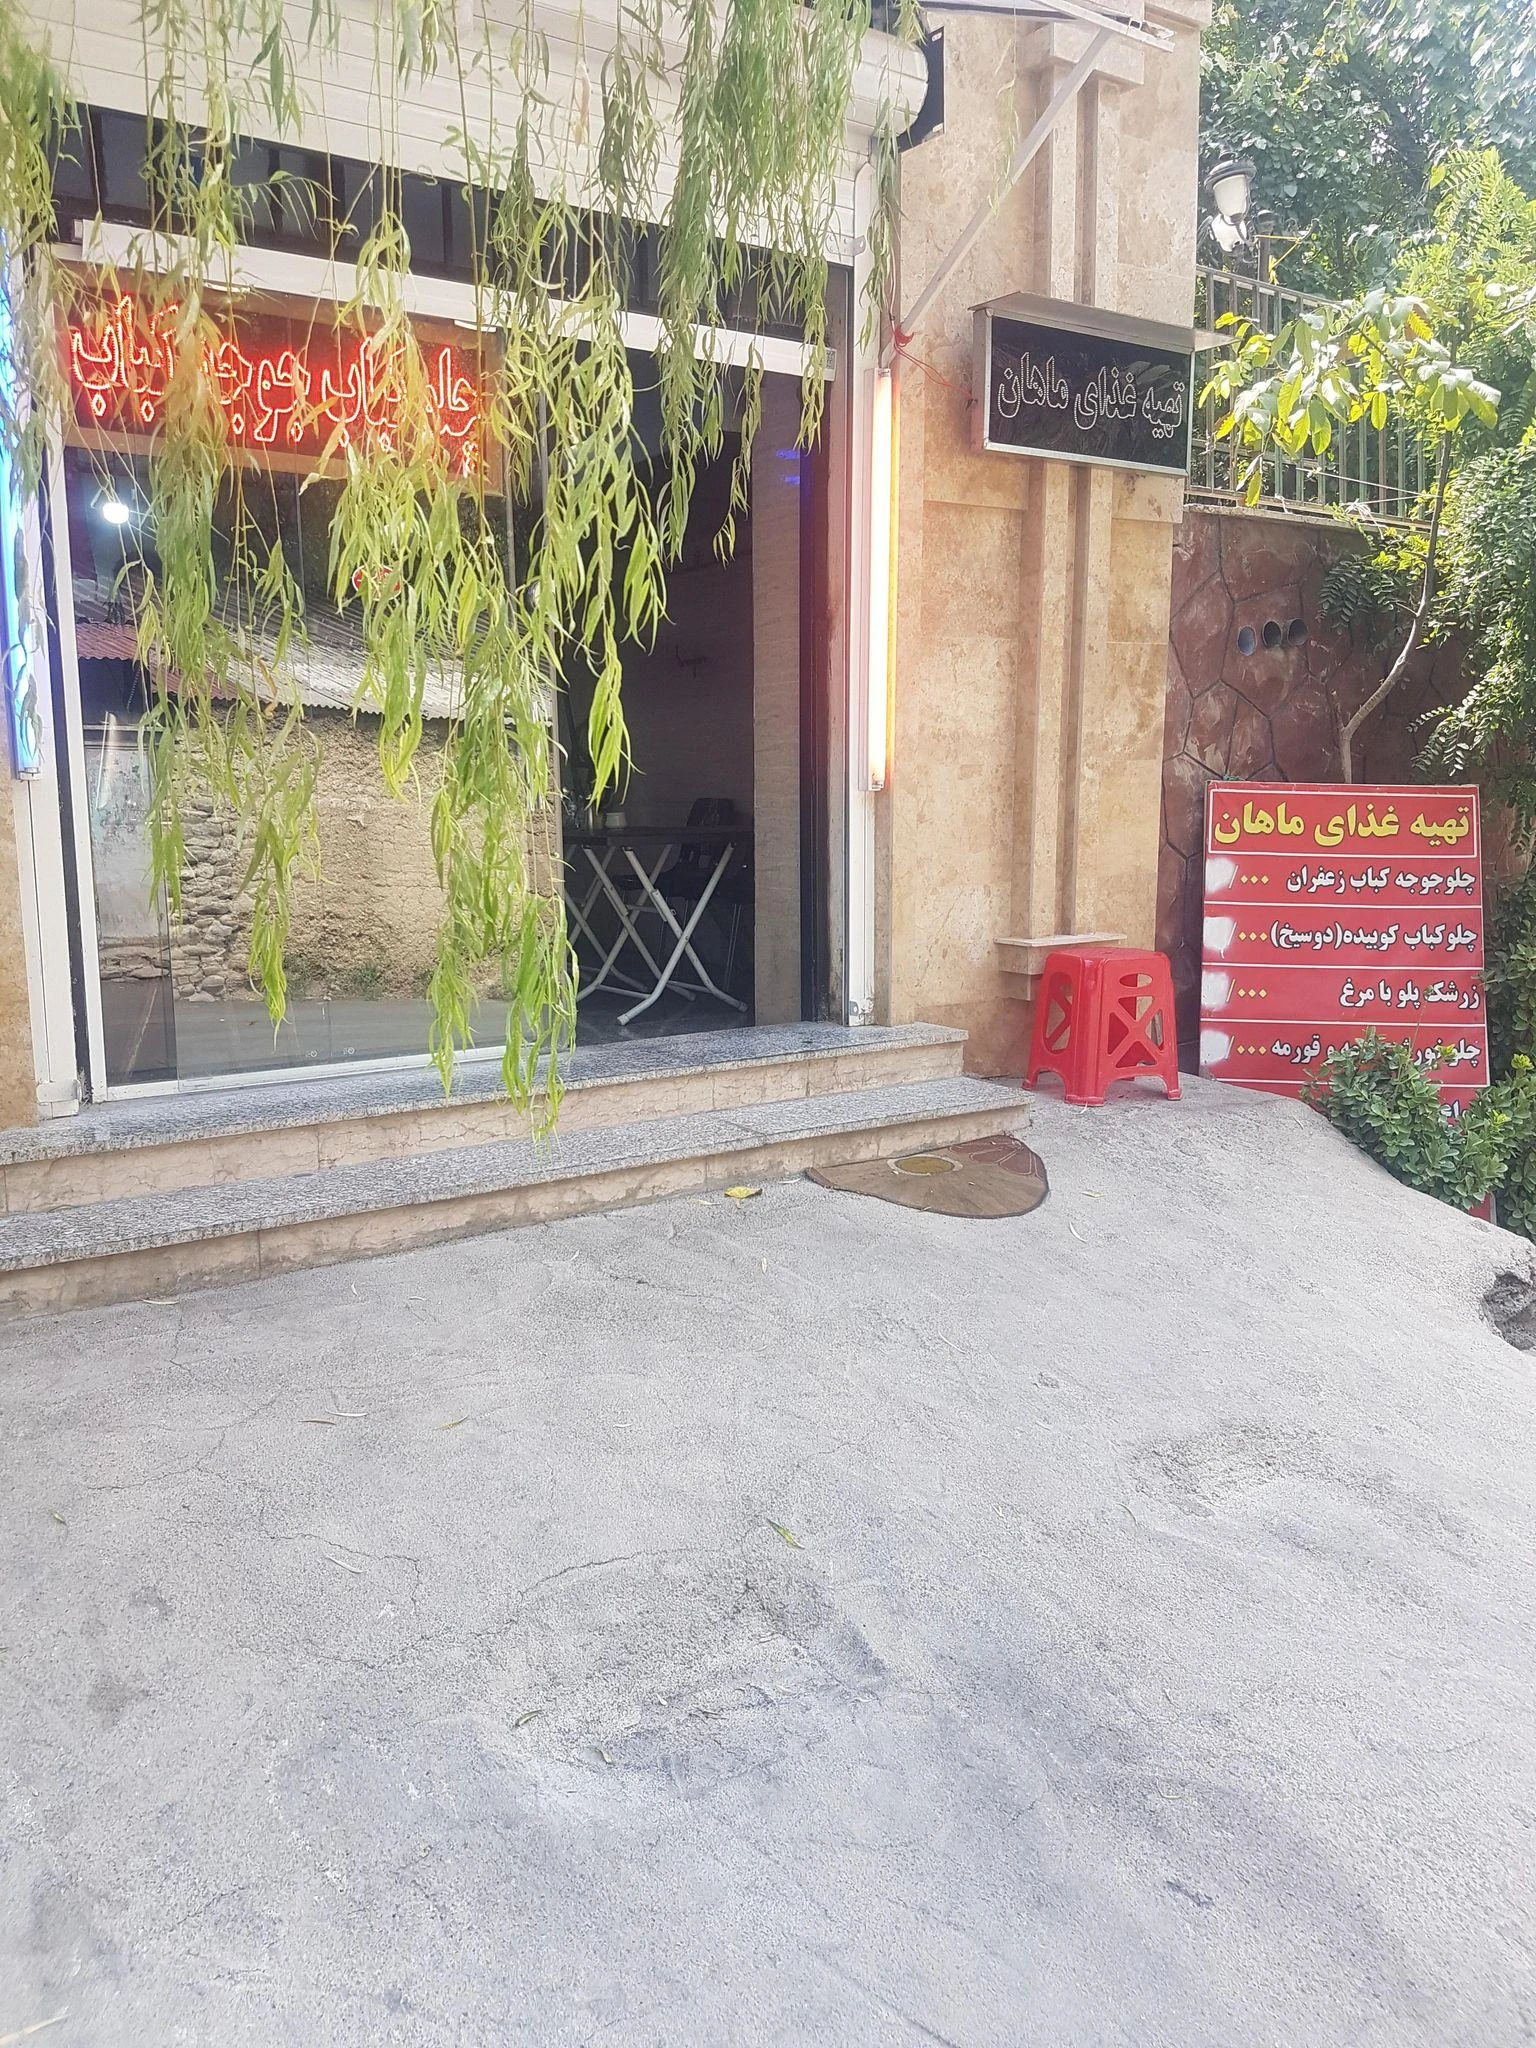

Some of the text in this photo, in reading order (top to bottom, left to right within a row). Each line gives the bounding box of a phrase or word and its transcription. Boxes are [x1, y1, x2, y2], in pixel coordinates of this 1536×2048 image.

[998, 351, 1185, 439] تهیه غذای ماهان
[1214, 801, 1470, 847] تهیه غذای ماهان
[1286, 865, 1346, 894] زعفران
[1349, 866, 1391, 894] کباب
[1339, 977, 1375, 1008] مرغ
[1378, 979, 1393, 1008] با
[1396, 980, 1420, 1009] پلو
[1424, 981, 1480, 1009] زرشک
[1271, 1034, 1321, 1064] قورمه
